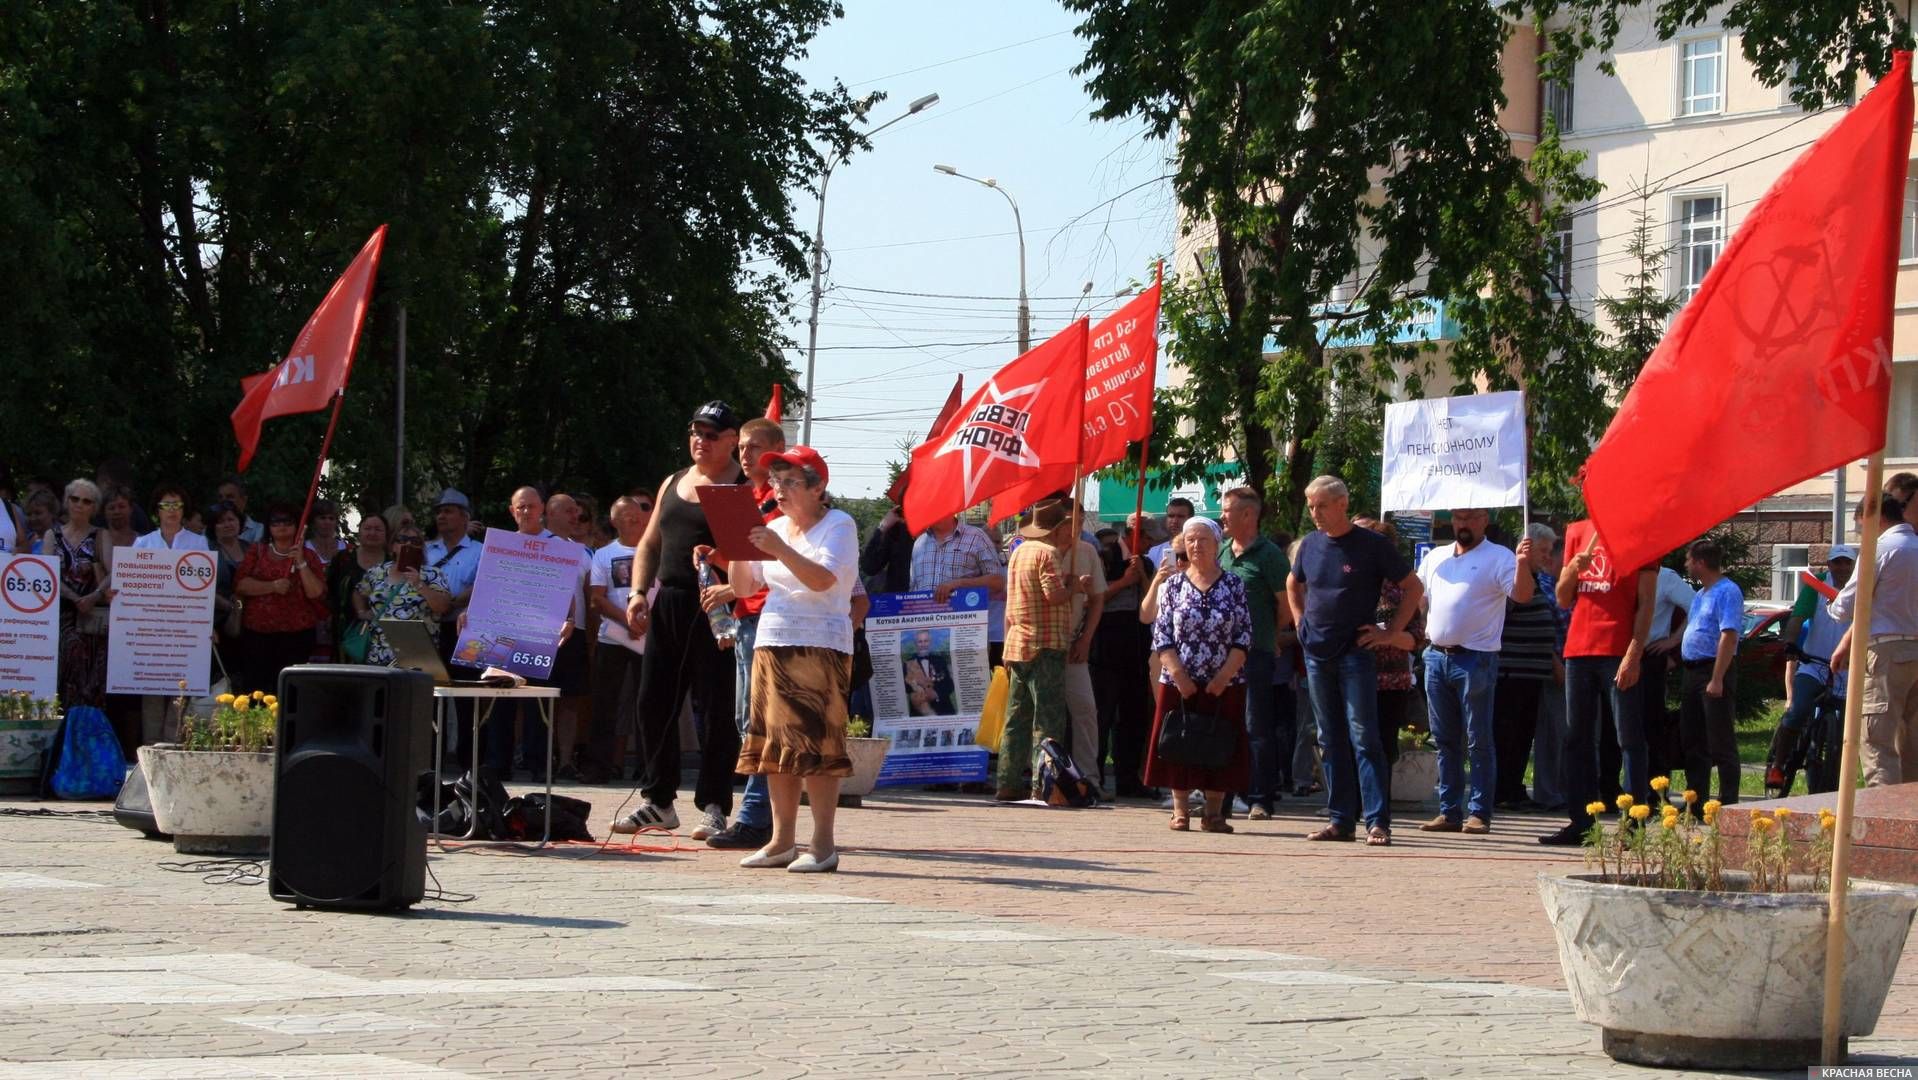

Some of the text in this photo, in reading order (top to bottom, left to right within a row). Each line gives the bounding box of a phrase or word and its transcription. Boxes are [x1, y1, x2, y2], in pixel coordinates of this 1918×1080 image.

[1407, 435, 1495, 457] ПЕНСИОННОМУ
[523, 539, 549, 552] НЕТ
[136, 552, 155, 560] НЕТ
[486, 545, 539, 560] ПЕНСИОННОЙ
[117, 562, 172, 570] повышению
[179, 566, 212, 578] 65:63
[116, 571, 173, 580] пенсионного
[6, 577, 52, 593] 65:63
[122, 581, 165, 590] возраста!
[901, 614, 934, 623] Анатолий
[935, 612, 977, 621] Степанович
[512, 651, 552, 668] 65:63
